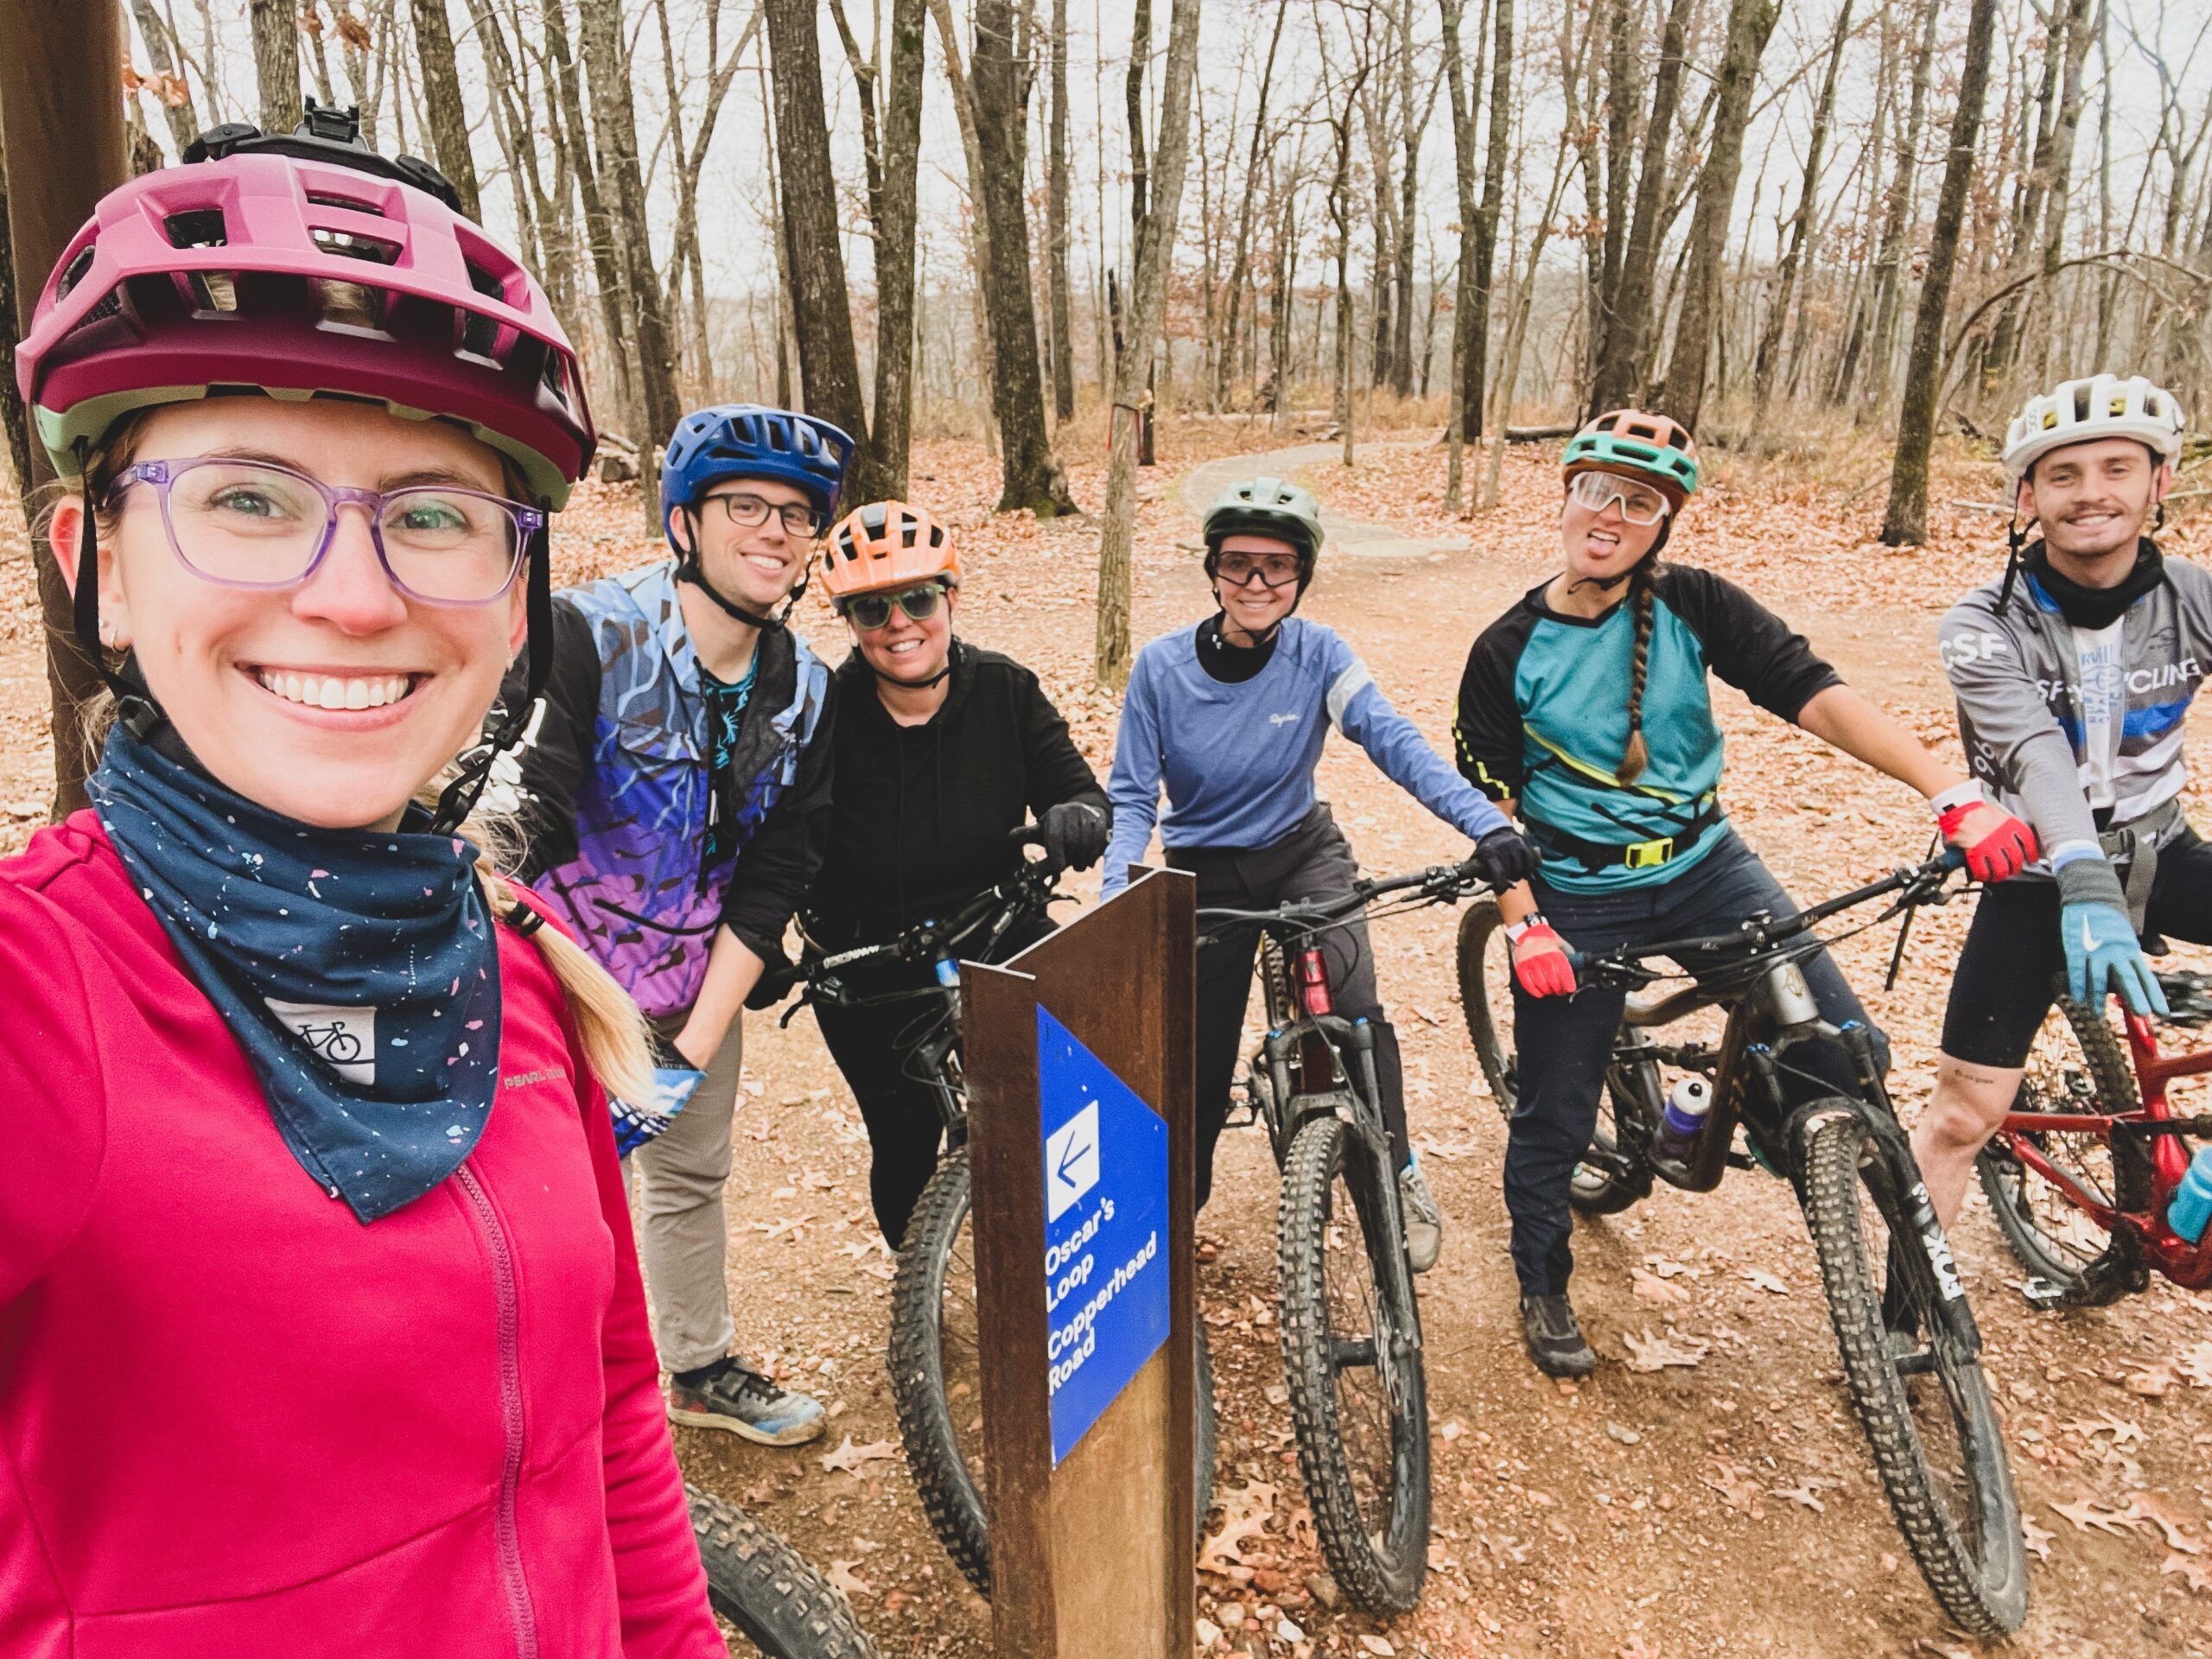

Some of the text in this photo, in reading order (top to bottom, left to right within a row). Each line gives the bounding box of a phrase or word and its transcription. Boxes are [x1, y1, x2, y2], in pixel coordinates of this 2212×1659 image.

[504, 1071, 546, 1090] PEARL
[1045, 1198, 1115, 1276] Oscar's
[1922, 1231, 1965, 1301] FOX
[1046, 1253, 1095, 1313] Loop
[1048, 1230, 1157, 1361] Copperhead
[1049, 1326, 1096, 1397] Road
